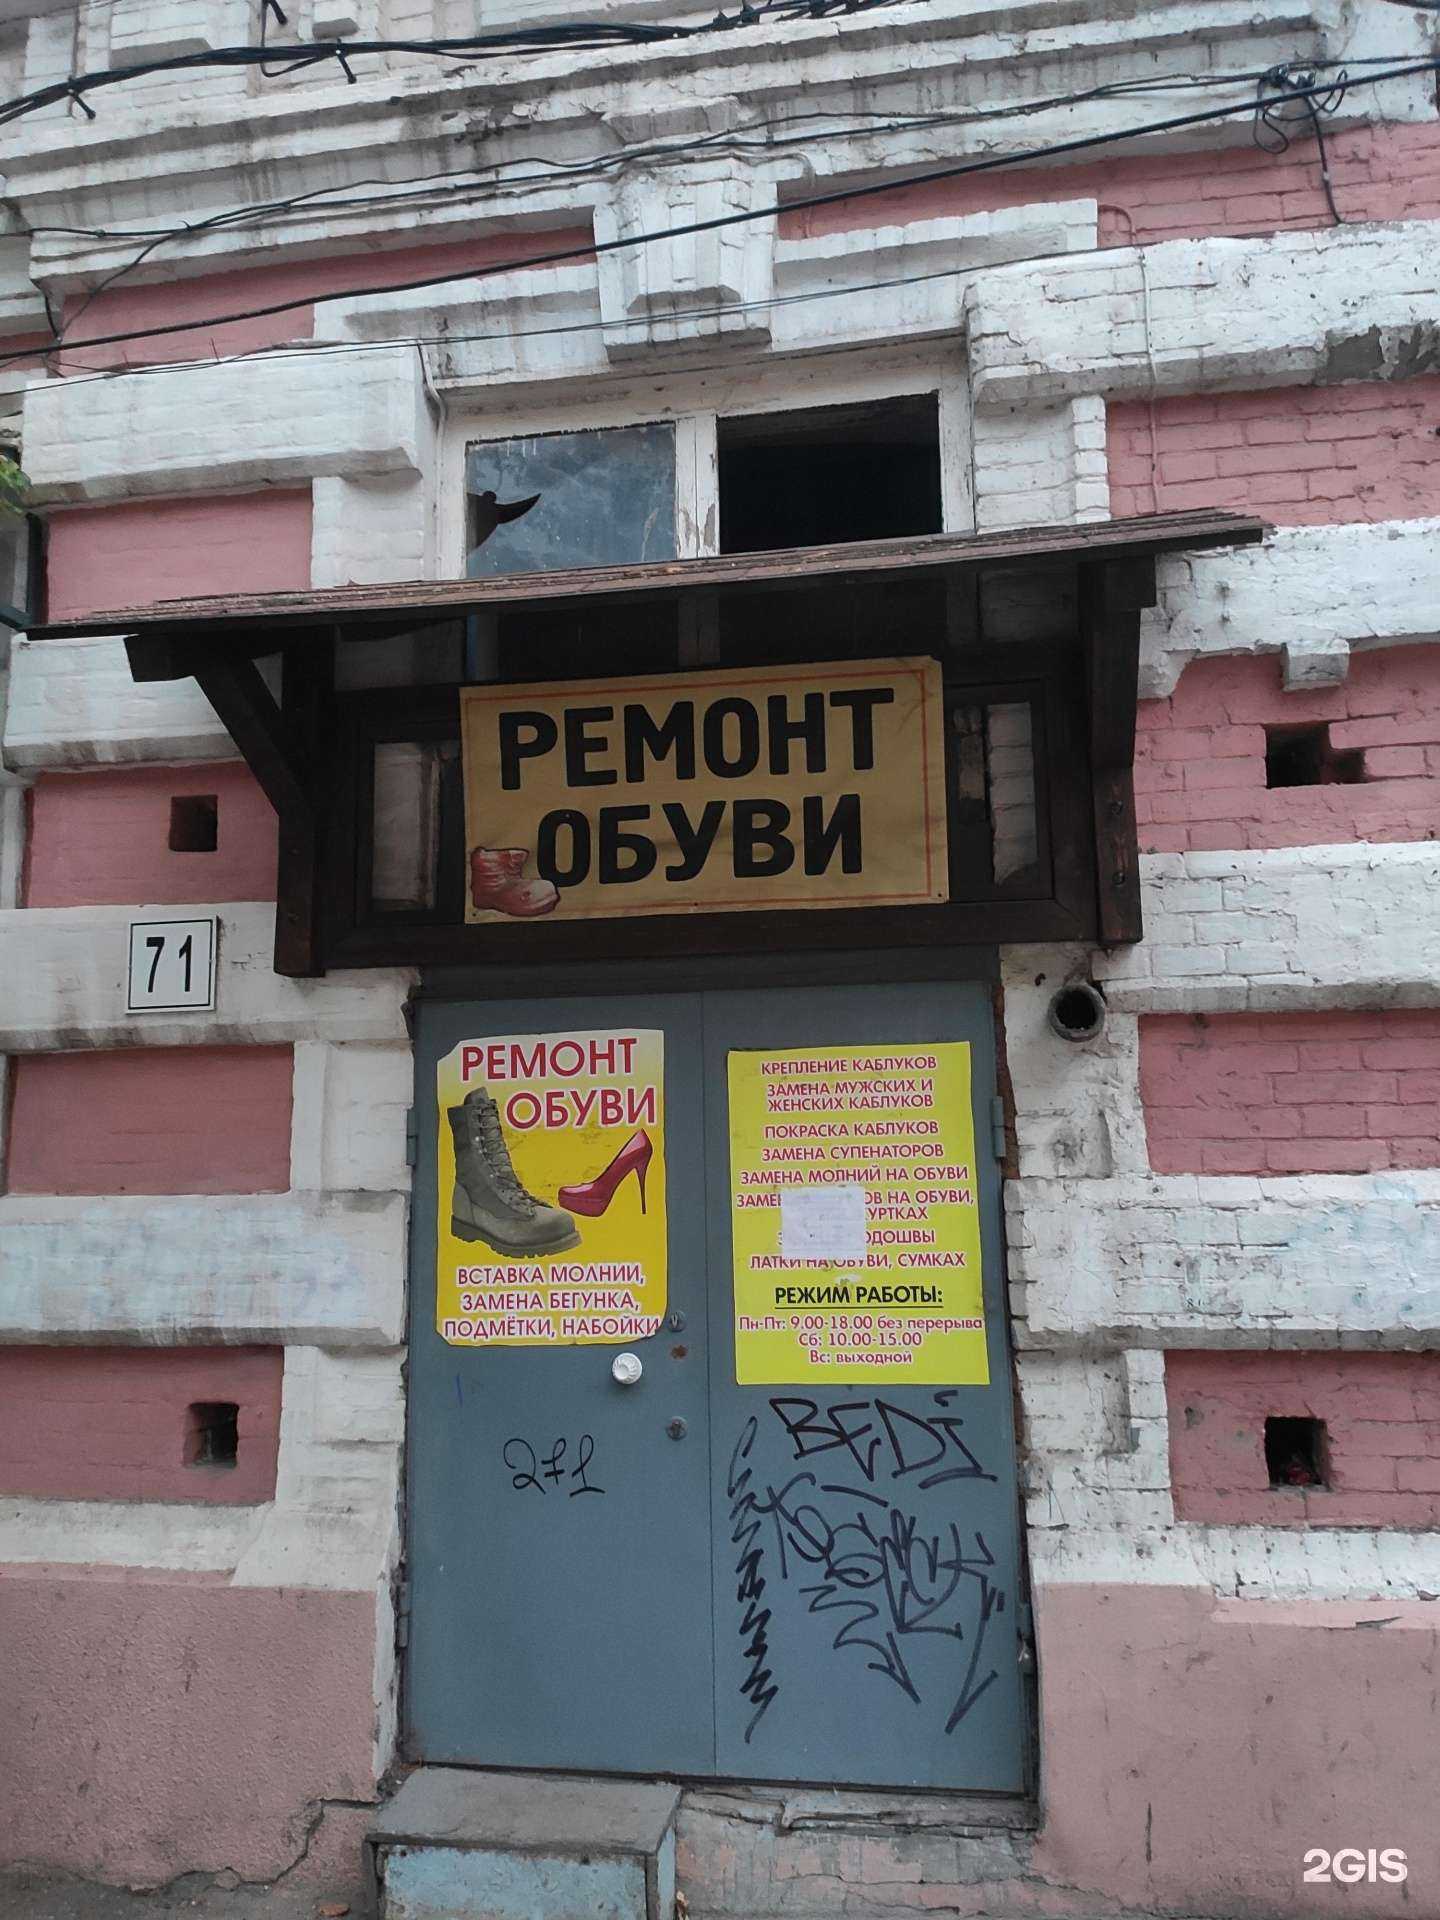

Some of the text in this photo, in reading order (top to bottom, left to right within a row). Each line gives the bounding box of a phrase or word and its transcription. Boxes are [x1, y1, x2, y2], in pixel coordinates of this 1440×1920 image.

[499, 688, 894, 790] РЕМОНТ
[537, 794, 862, 888] ОБУВИ
[146, 935, 192, 993] 71
[462, 1038, 638, 1081] РЕМОНТ
[761, 1056, 937, 1075] КРЕПЛЕНИЕ КАБЛУКОВ
[768, 1079, 933, 1097] ЗАМЕНА МУЖСКИХ И
[506, 1087, 655, 1129] ОБУВИ
[768, 1094, 933, 1112] ЖЕНСКИХ КАБЛУКОВ
[765, 1121, 939, 1139] ПОКРАСКА КАБЛУКОВ
[762, 1144, 944, 1161] ЗАМЕНА СУПЕНАТОРОВ
[741, 1164, 968, 1184] ЗАМЕНА МОЛНИЙ НА ОБУВИ
[888, 1191, 911, 1204] НА
[915, 1190, 974, 1204] ОБУВИ,
[866, 1206, 929, 1220] УРТКАХ
[897, 1252, 966, 1267] СУМКАХ
[457, 1265, 644, 1284] ВСТАВКА МОЛНИИ,
[462, 1291, 640, 1311] ЗАМЕНА БЕГУНКА,
[775, 1285, 943, 1304] РЕЖИМ РАБОТЫ:
[444, 1315, 659, 1338] ПОДМЁТКИ, НАБОЙКИ
[739, 1315, 983, 1334] Пн-Пт: 9.00-18.00 без перерыва
[799, 1331, 922, 1346] Сб: 10.00-15.00
[810, 1349, 913, 1364] Вс: выходной
